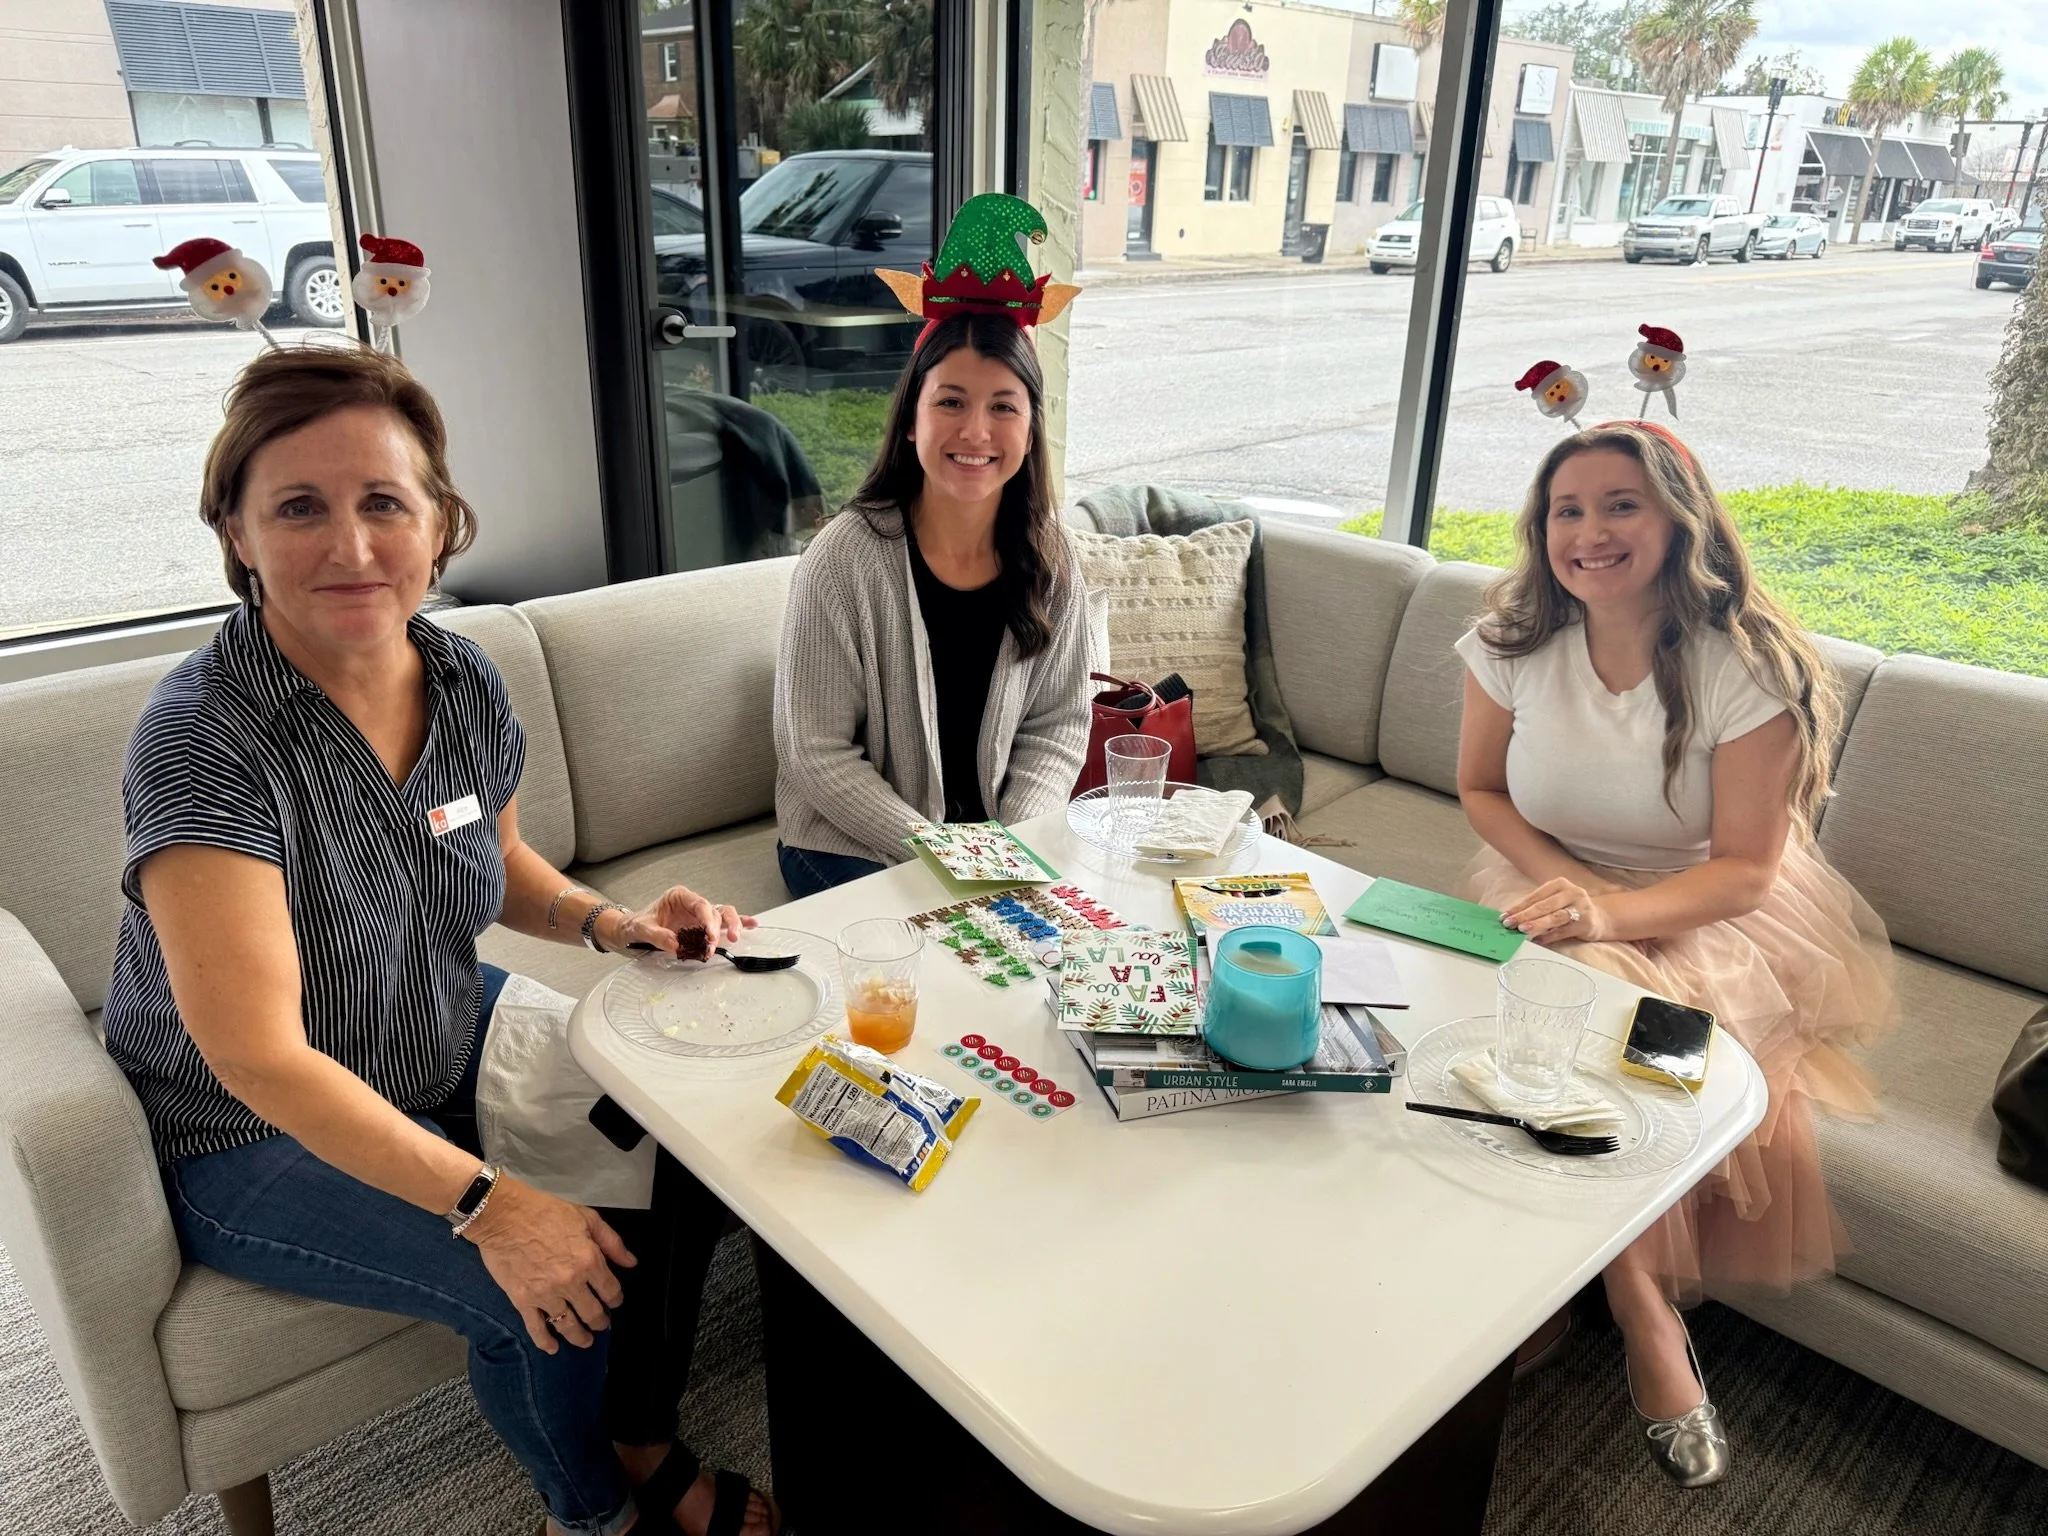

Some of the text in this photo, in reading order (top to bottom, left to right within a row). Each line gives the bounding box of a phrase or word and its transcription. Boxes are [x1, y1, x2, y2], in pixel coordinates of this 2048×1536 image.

[934, 833, 970, 844] LA
[961, 844, 999, 856] LA
[983, 856, 1020, 869] FA
[1207, 881, 1282, 891] Crayola
[1210, 907, 1305, 919] WASHABLE
[1226, 916, 1301, 926] MARKERS
[1086, 947, 1165, 966] la LA
[1108, 965, 1151, 983] LA
[1086, 983, 1167, 1003] FA la
[1162, 1074, 1239, 1087] URBAN STYLE
[1281, 1079, 1318, 1088] SARA EMSLIE
[809, 1091, 829, 1118] Nutrition
[827, 1076, 840, 1092] Facts
[847, 1087, 859, 1101] 120
[1146, 1088, 1217, 1112] PATINA
